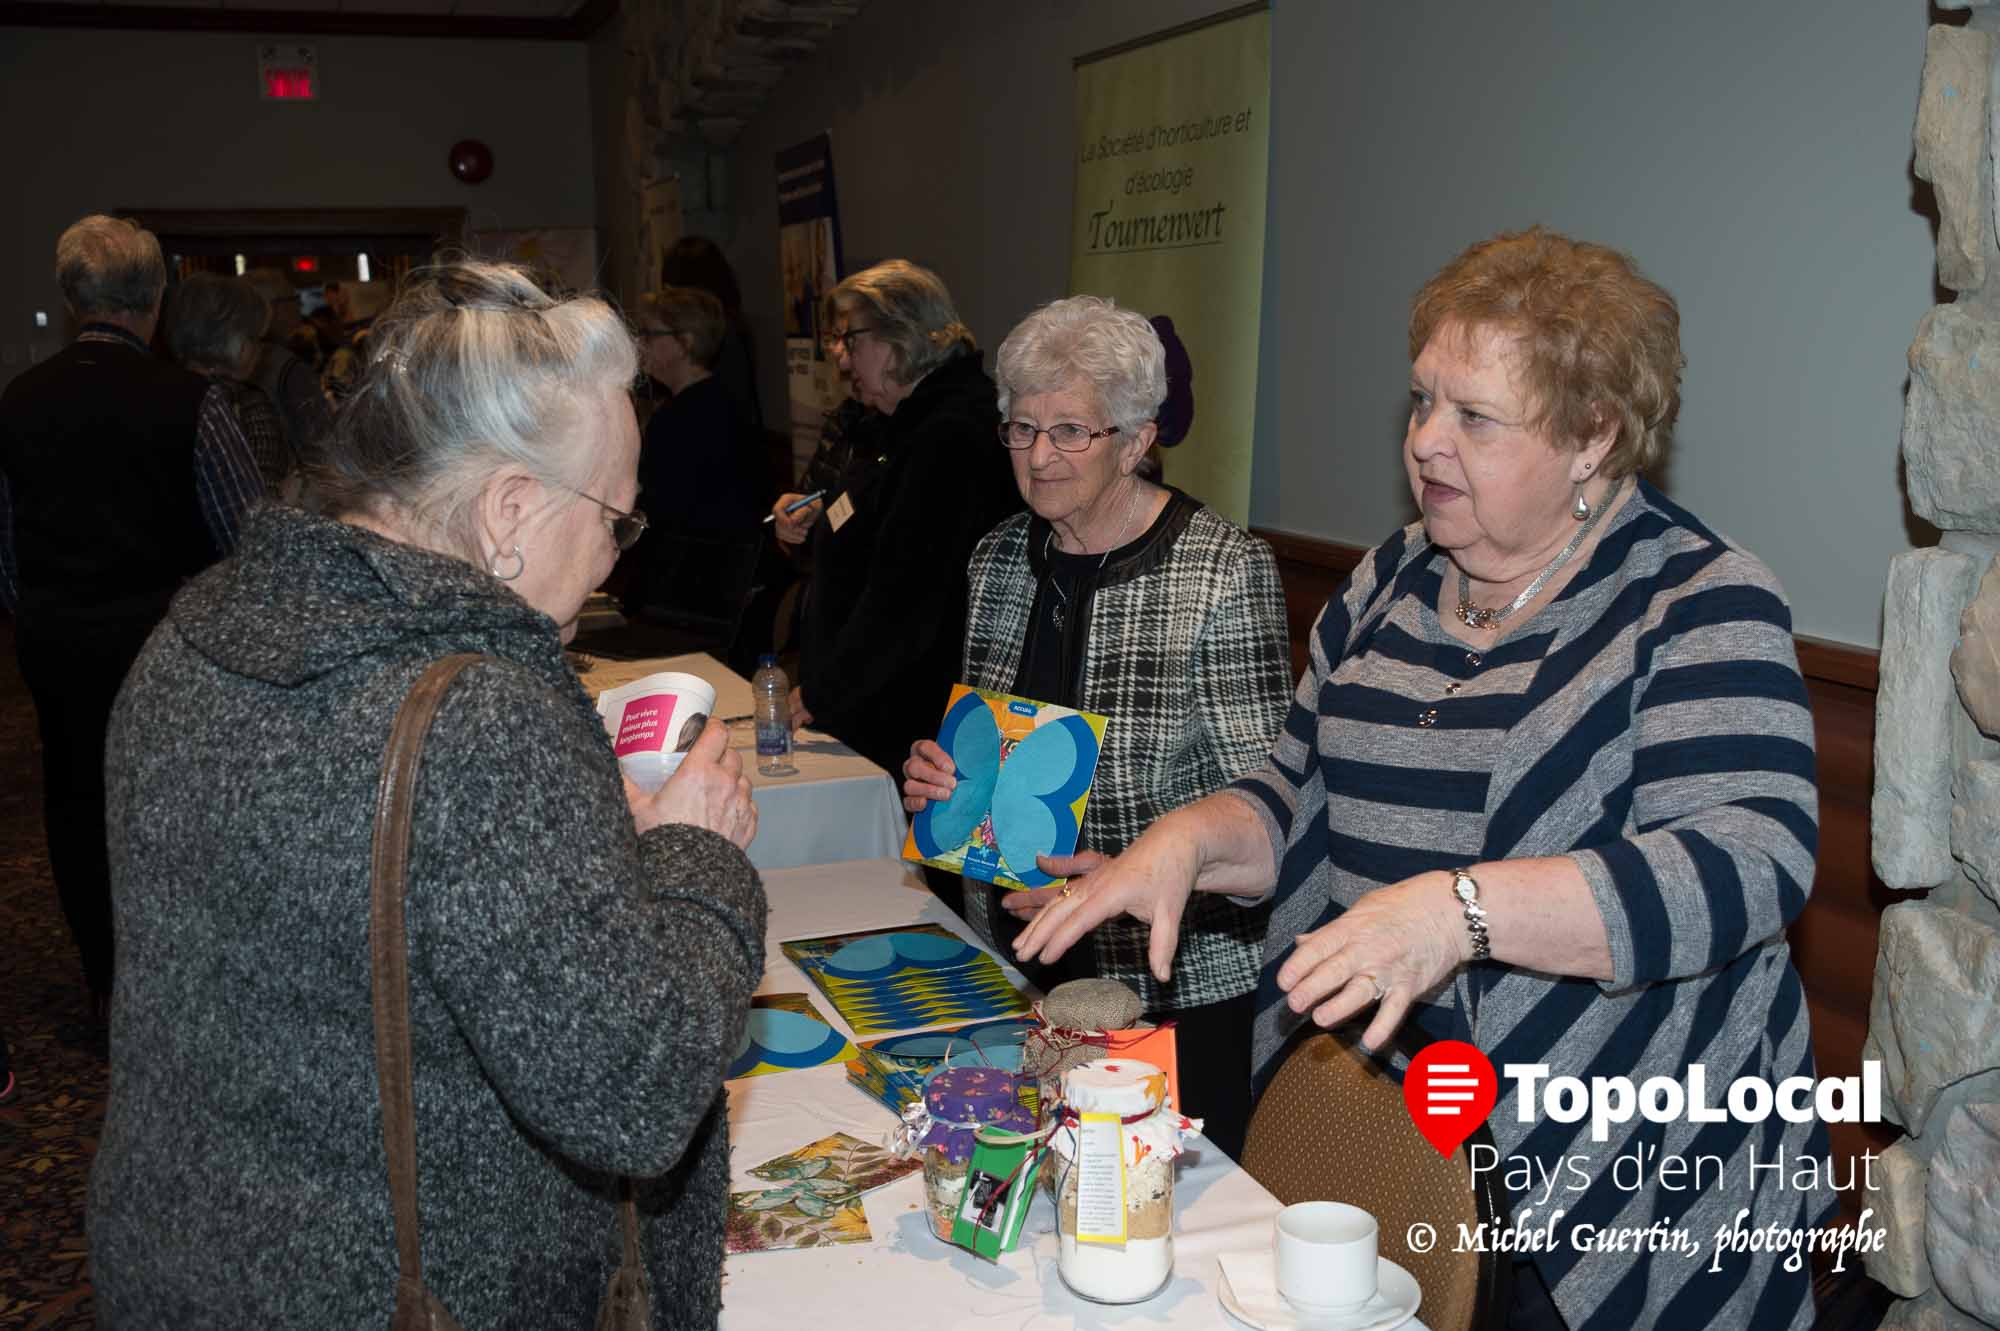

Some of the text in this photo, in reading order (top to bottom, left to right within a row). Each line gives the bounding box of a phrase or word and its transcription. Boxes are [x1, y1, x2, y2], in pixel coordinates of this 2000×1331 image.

[1080, 107, 1252, 163] La Société d'horticulture et
[1125, 164, 1194, 195] d'écologie
[1089, 200, 1225, 249] Tournenvert
[641, 707, 658, 718] vivre
[641, 719, 658, 730] plus
[619, 730, 655, 745] longtemps
